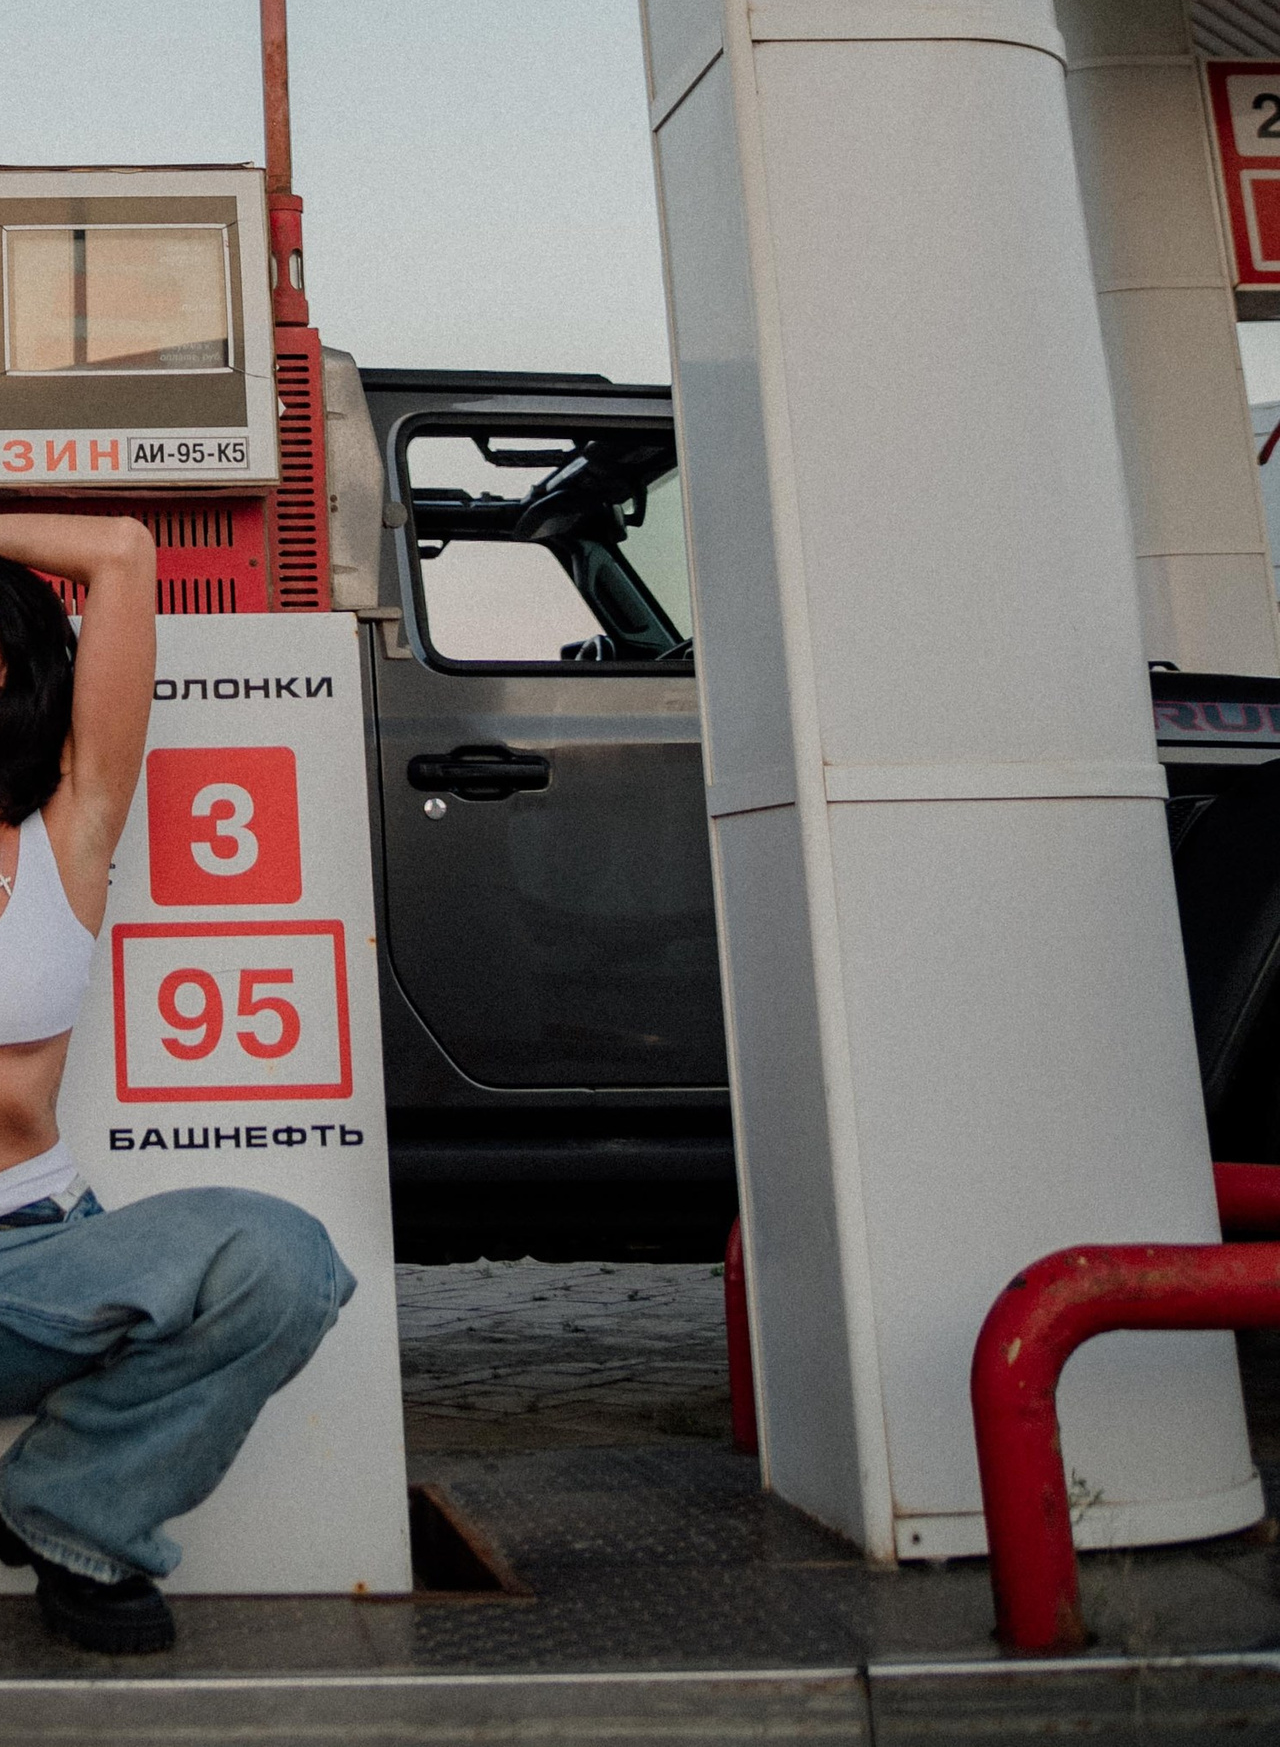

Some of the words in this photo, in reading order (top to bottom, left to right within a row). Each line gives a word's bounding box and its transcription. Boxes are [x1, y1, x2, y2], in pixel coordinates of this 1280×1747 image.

[134, 442, 245, 464] АИ-95-К5
[190, 783, 259, 876] 3
[157, 968, 301, 1060] 95
[110, 1124, 364, 1151] БАШНЕФТЬ
